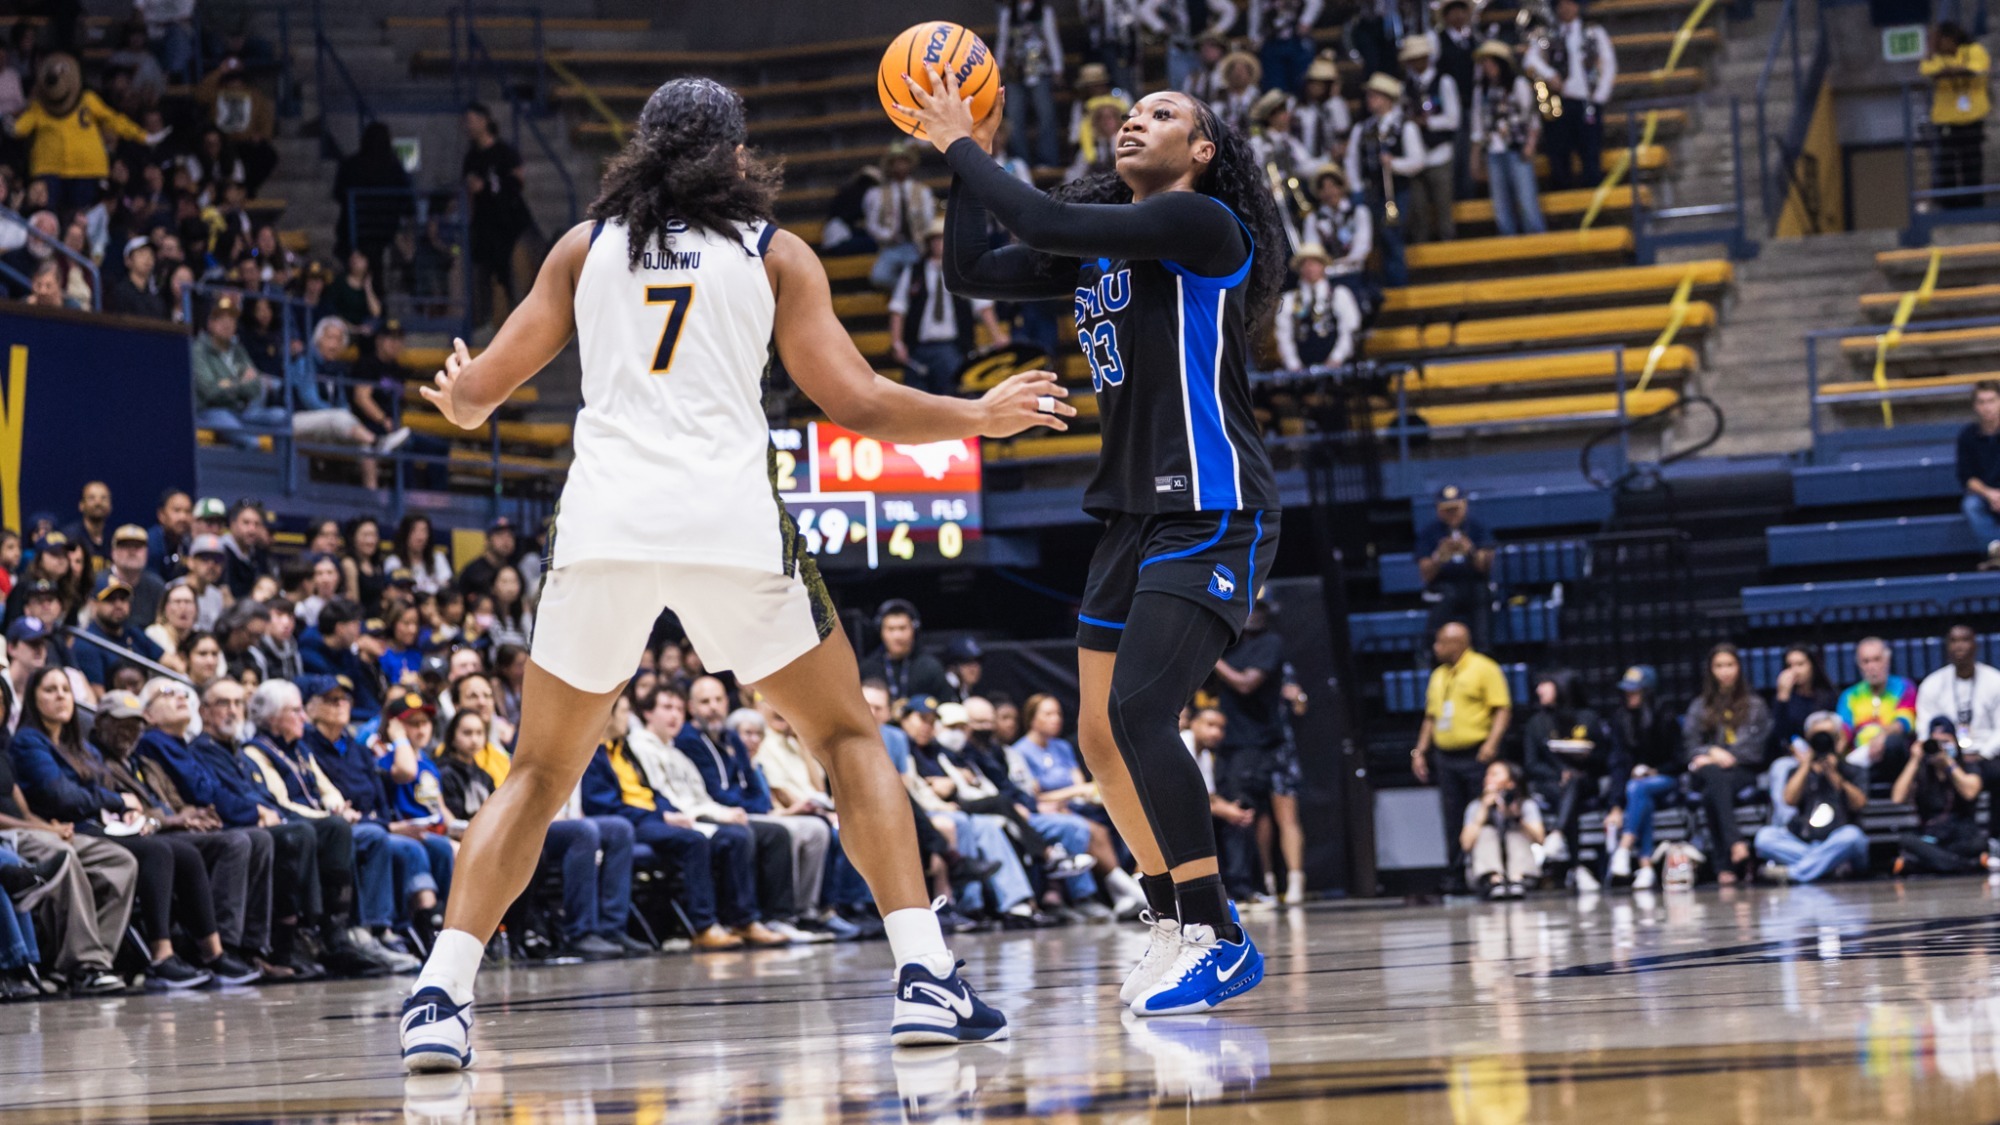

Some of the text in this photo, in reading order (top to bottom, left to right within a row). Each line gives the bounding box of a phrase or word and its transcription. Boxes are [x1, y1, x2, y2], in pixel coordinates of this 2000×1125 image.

[643, 251, 701, 270] OJUKWU
[1074, 268, 1131, 328] SMU
[644, 283, 695, 375] 7
[1077, 319, 1126, 393] 33
[829, 436, 884, 482] 10
[1173, 479, 1184, 488] XL
[938, 521, 963, 559] 0
